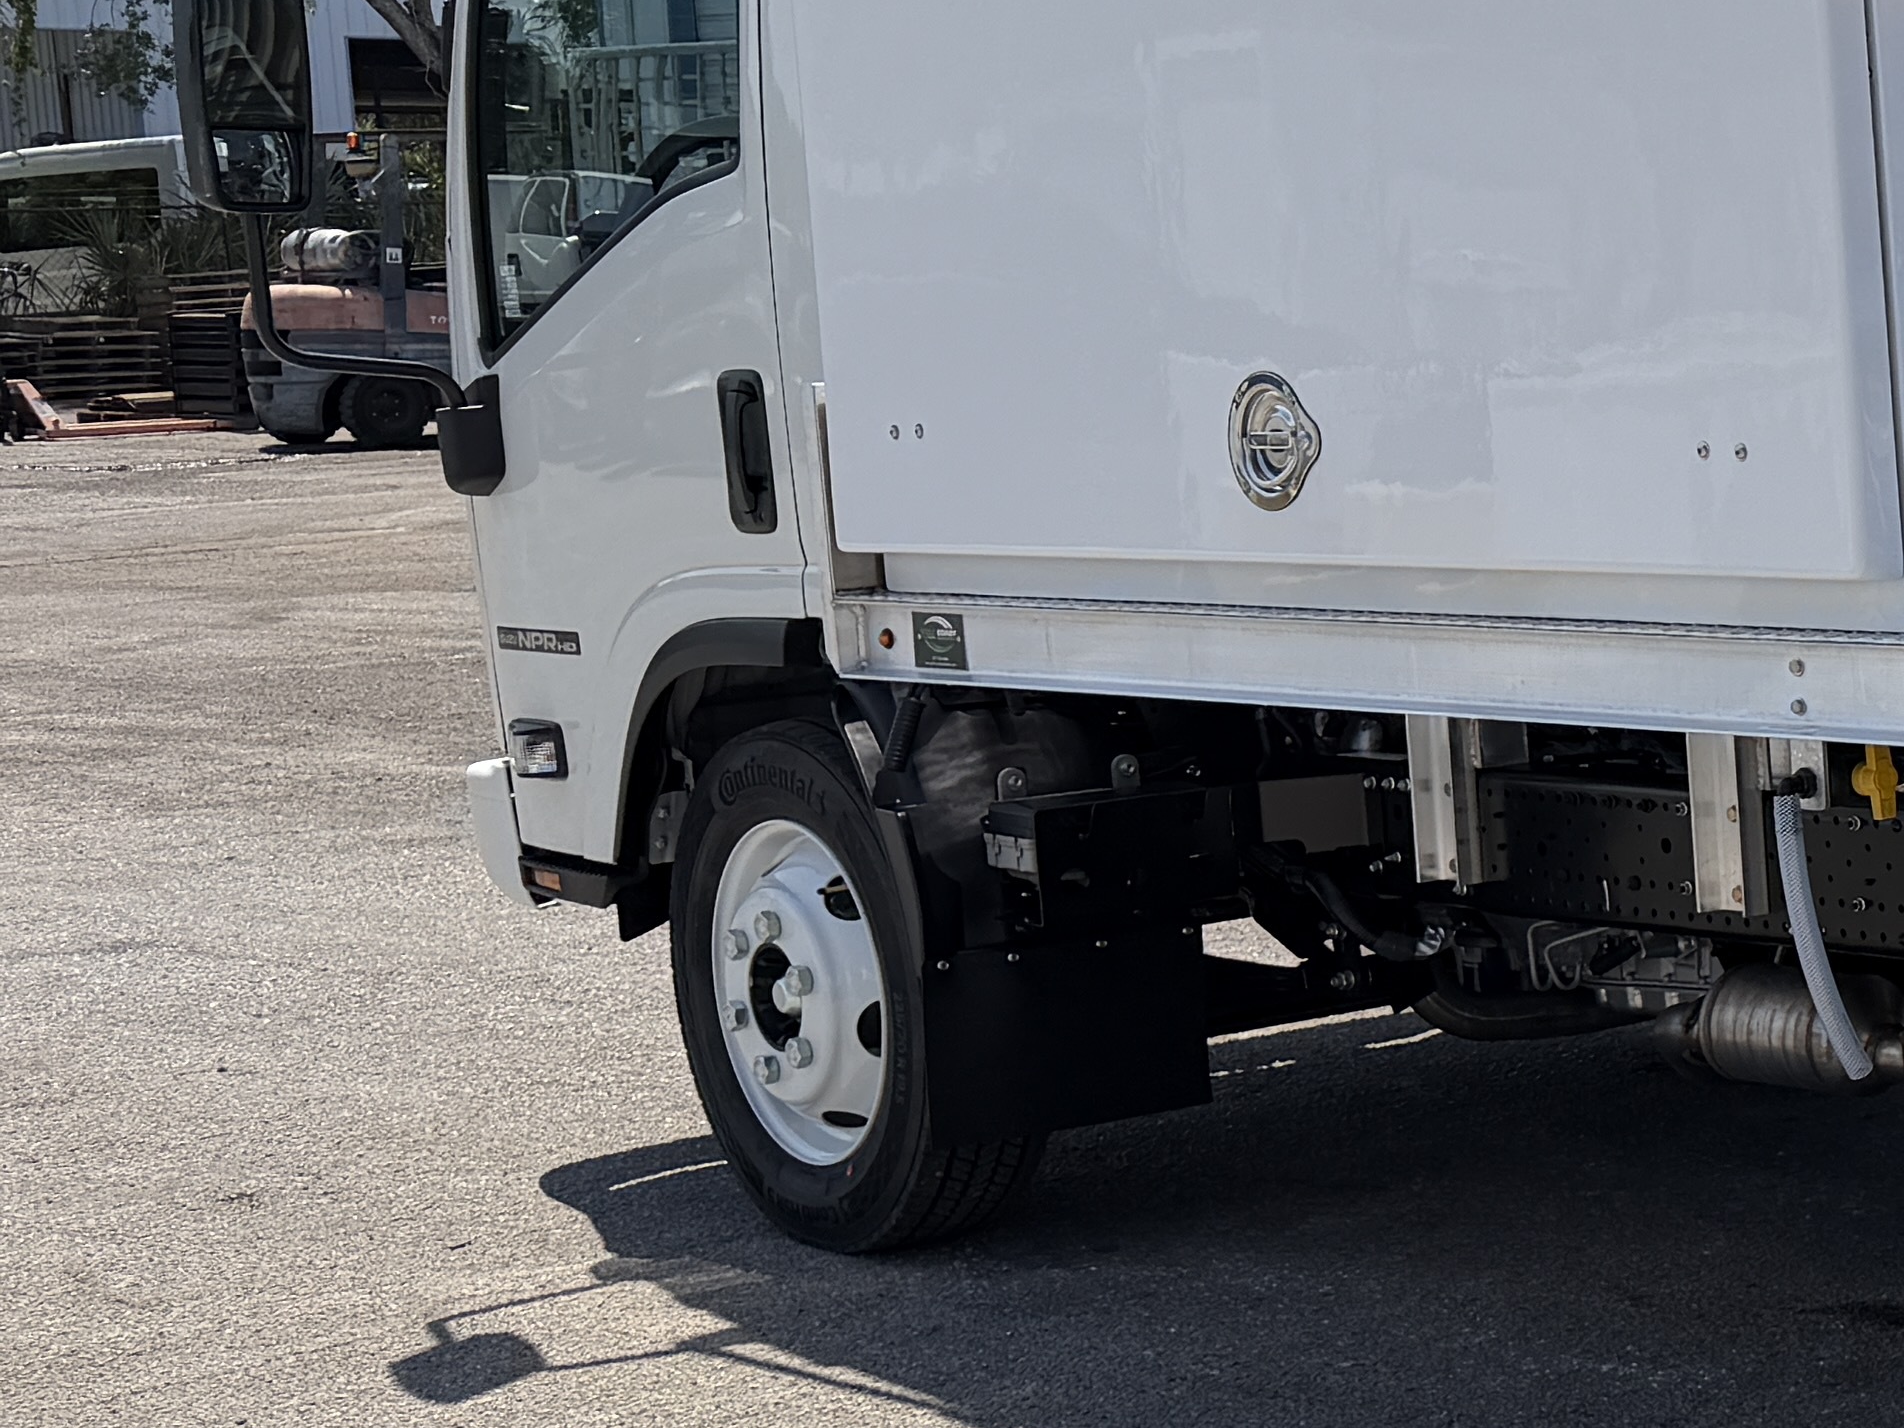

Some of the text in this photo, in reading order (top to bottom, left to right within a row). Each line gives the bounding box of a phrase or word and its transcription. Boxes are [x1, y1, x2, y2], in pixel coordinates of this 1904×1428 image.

[429, 315, 448, 325] TO
[518, 630, 557, 651] NPR
[717, 756, 816, 807] Continental
